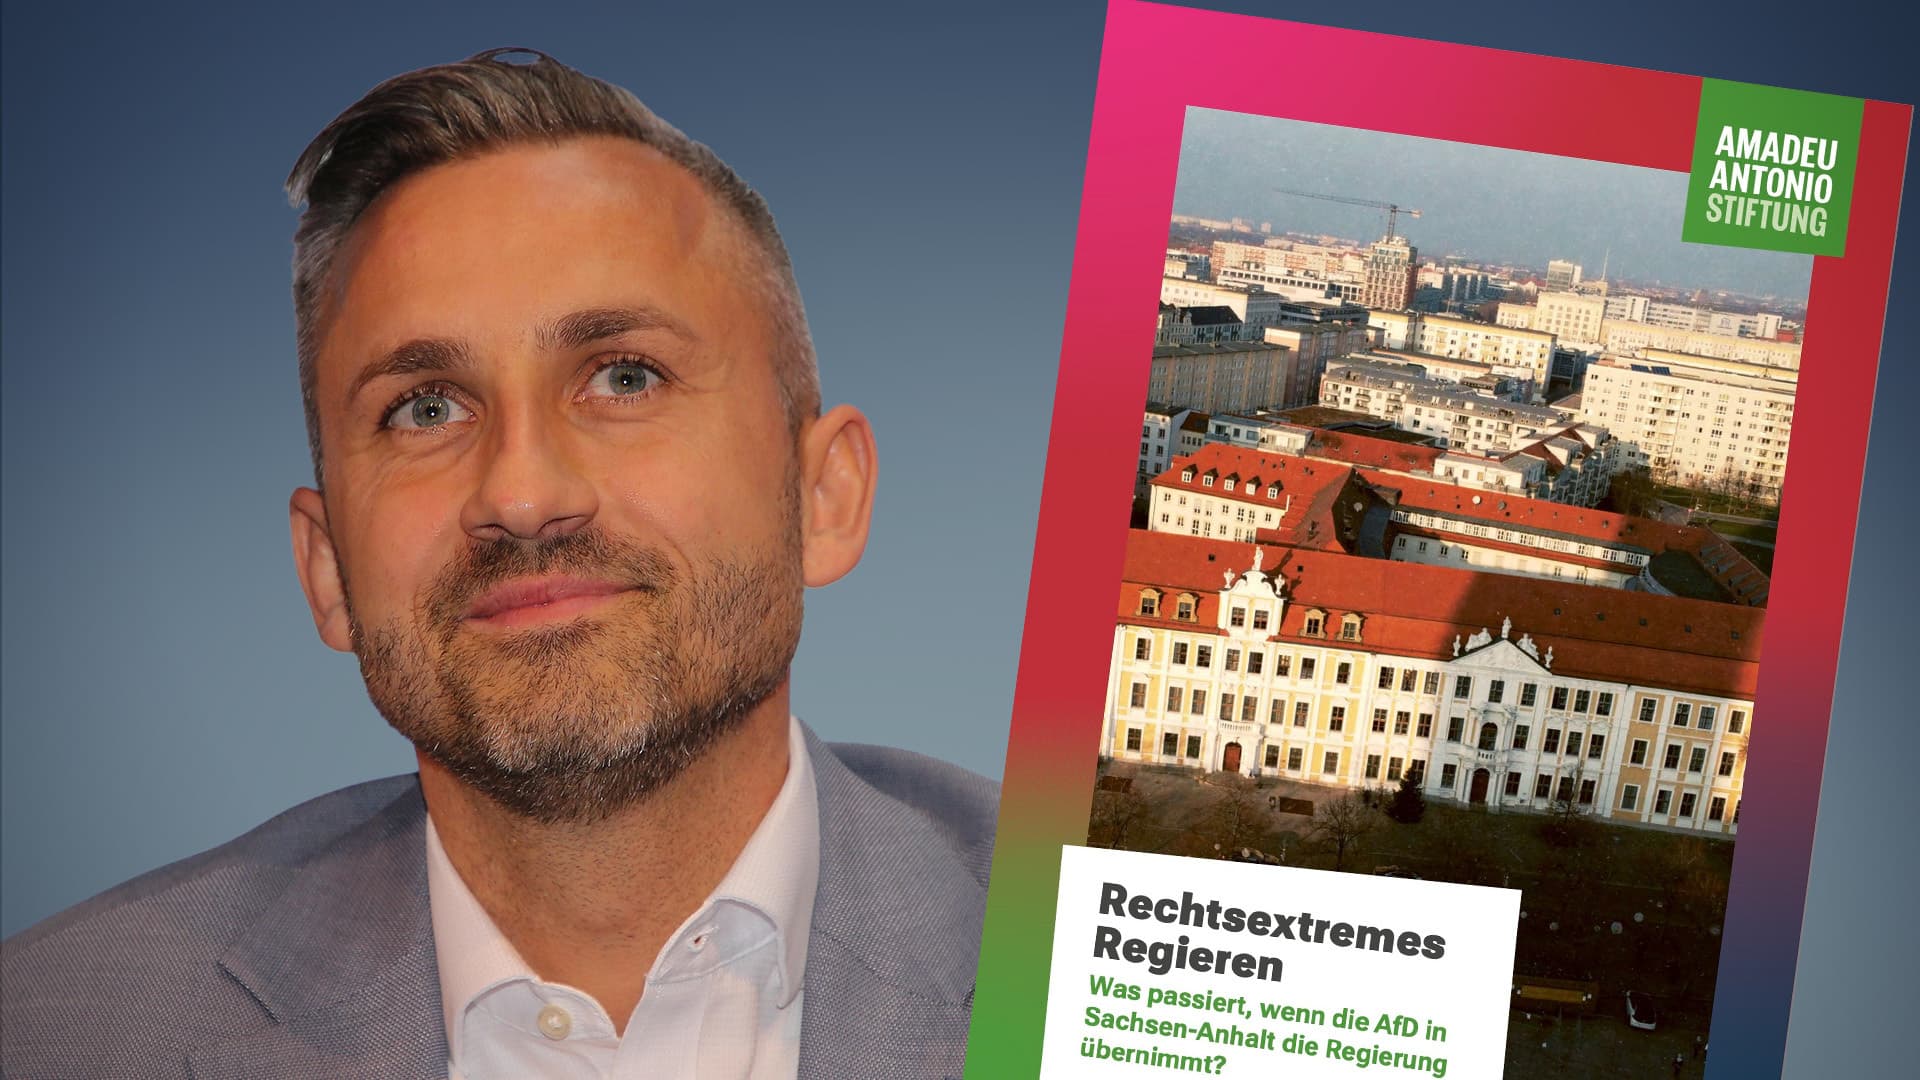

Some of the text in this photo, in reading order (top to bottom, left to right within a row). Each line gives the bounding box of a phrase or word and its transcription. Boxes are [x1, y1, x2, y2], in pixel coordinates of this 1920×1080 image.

[1714, 125, 1839, 171] AMADEU
[1708, 159, 1834, 204] ANTONIO
[1705, 192, 1828, 238] STIFTUNG
[1098, 881, 1446, 960] Rechtsextremes
[1093, 925, 1284, 983] Regieren
[1089, 974, 1447, 1043] Was passiert, wenn die AfD in
[1080, 1036, 1227, 1075] übernimmt?
[1084, 1006, 1448, 1079] Sachsen-Anhalt die Regierung
